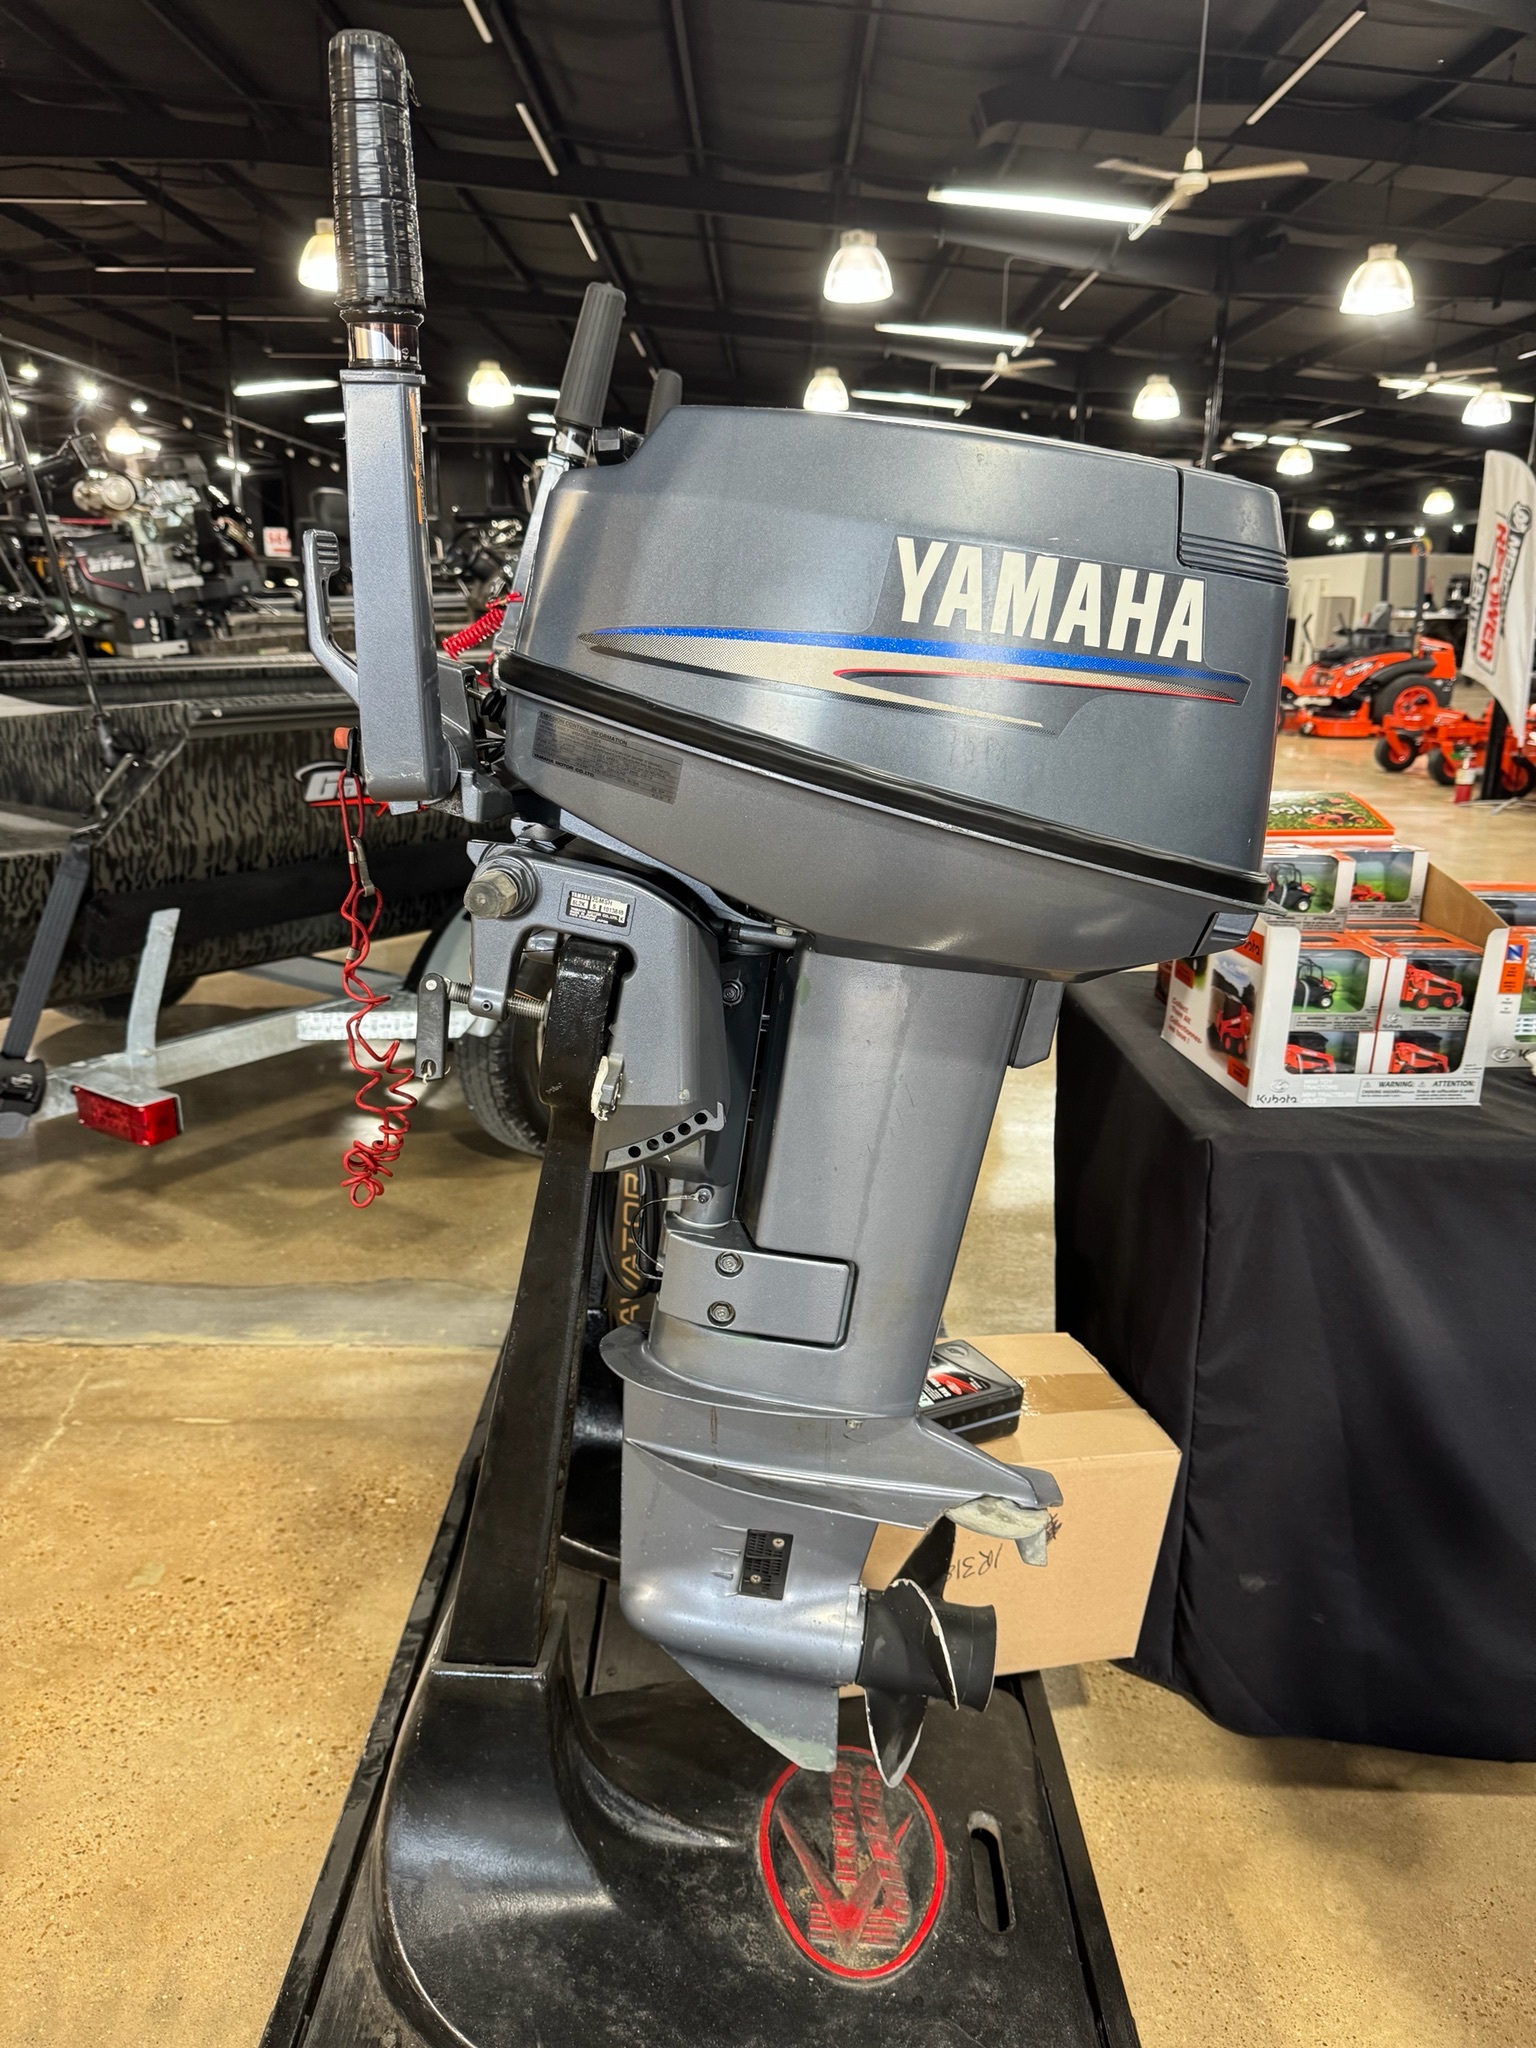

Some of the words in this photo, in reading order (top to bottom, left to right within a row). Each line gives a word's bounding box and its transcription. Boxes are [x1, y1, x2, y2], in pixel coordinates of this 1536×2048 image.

[896, 536, 1206, 663] YAMAHA
[564, 720, 590, 734] CONTROL
[591, 729, 628, 747] INFORMATION
[1256, 1094, 1297, 1104] Kubota
[618, 1172, 641, 1325] AVATOR
